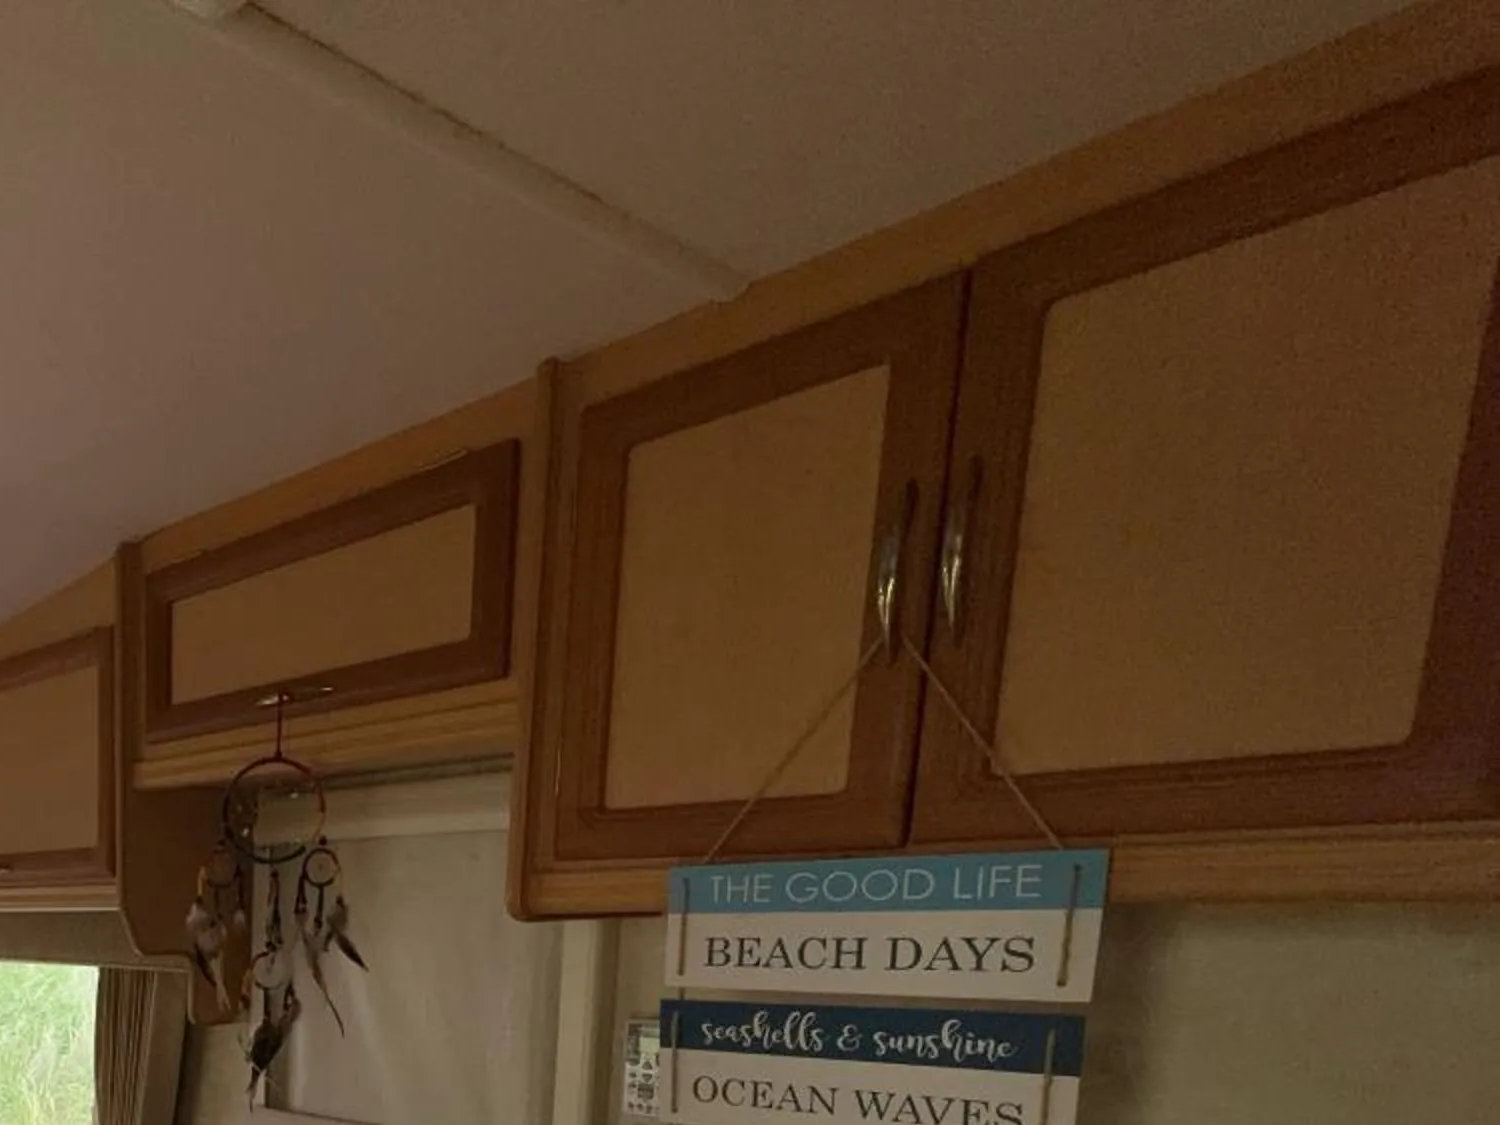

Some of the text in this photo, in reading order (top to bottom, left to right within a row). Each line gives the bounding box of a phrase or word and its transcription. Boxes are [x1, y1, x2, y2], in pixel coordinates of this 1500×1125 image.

[710, 863, 1043, 904] THE GOOD LIFE
[704, 936, 1037, 974] BEACH DAYS
[700, 1010, 1018, 1061] seashells & sunshine
[692, 1074, 840, 1116] OCEAN
